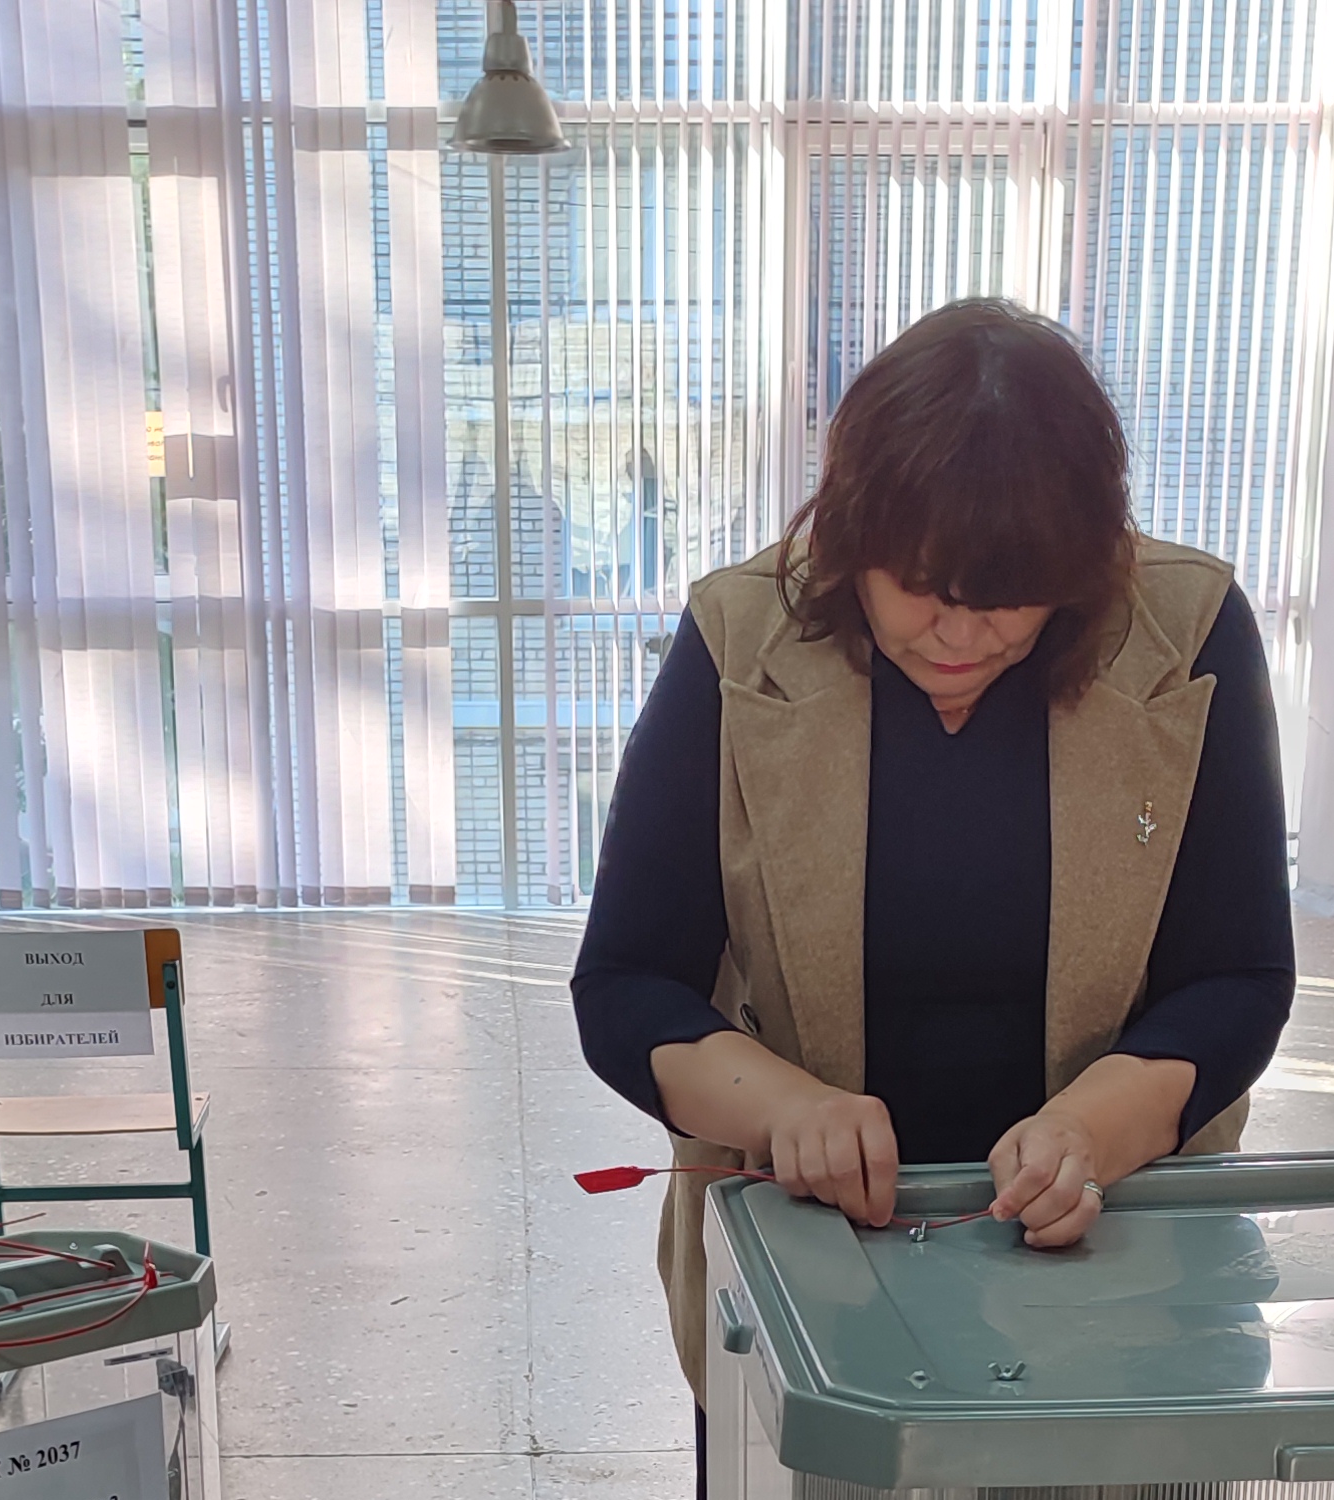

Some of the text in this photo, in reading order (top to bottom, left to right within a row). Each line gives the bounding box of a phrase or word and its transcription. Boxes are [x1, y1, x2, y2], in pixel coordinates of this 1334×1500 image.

[24, 952, 85, 966] ВЫХОД
[40, 993, 74, 1007] ДЛЯ
[4, 1029, 119, 1046] ИЗБИРАТЕЛЕЙ
[7, 1454, 31, 1476] №
[36, 1440, 81, 1469] 2037
